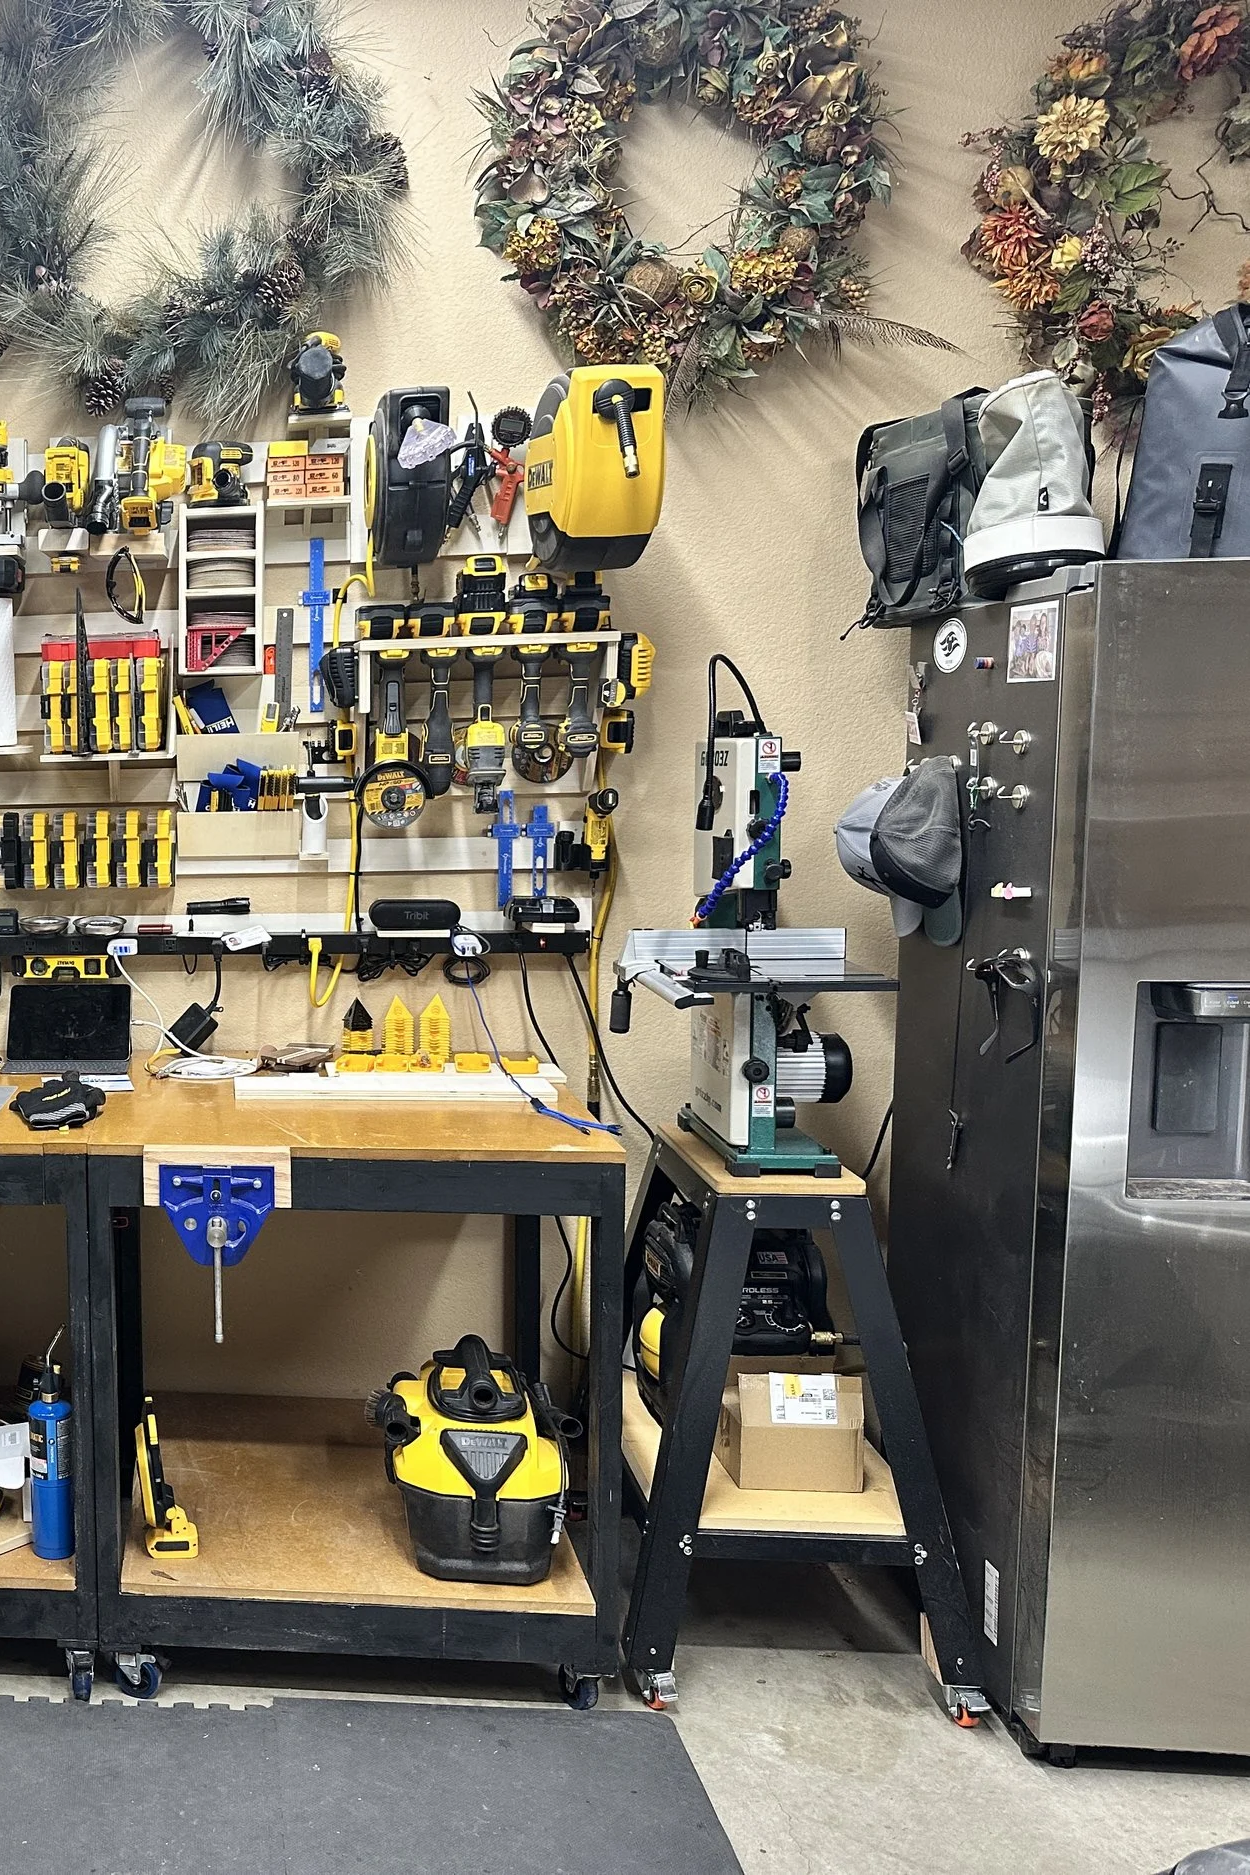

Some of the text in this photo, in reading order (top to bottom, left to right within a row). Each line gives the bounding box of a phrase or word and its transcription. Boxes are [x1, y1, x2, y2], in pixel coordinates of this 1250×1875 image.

[528, 462, 553, 489] DEWALT
[377, 771, 405, 781] DEWALT
[404, 911, 430, 920] Tribit
[758, 1252, 778, 1263] USA
[461, 1436, 507, 1448] DEWALT
